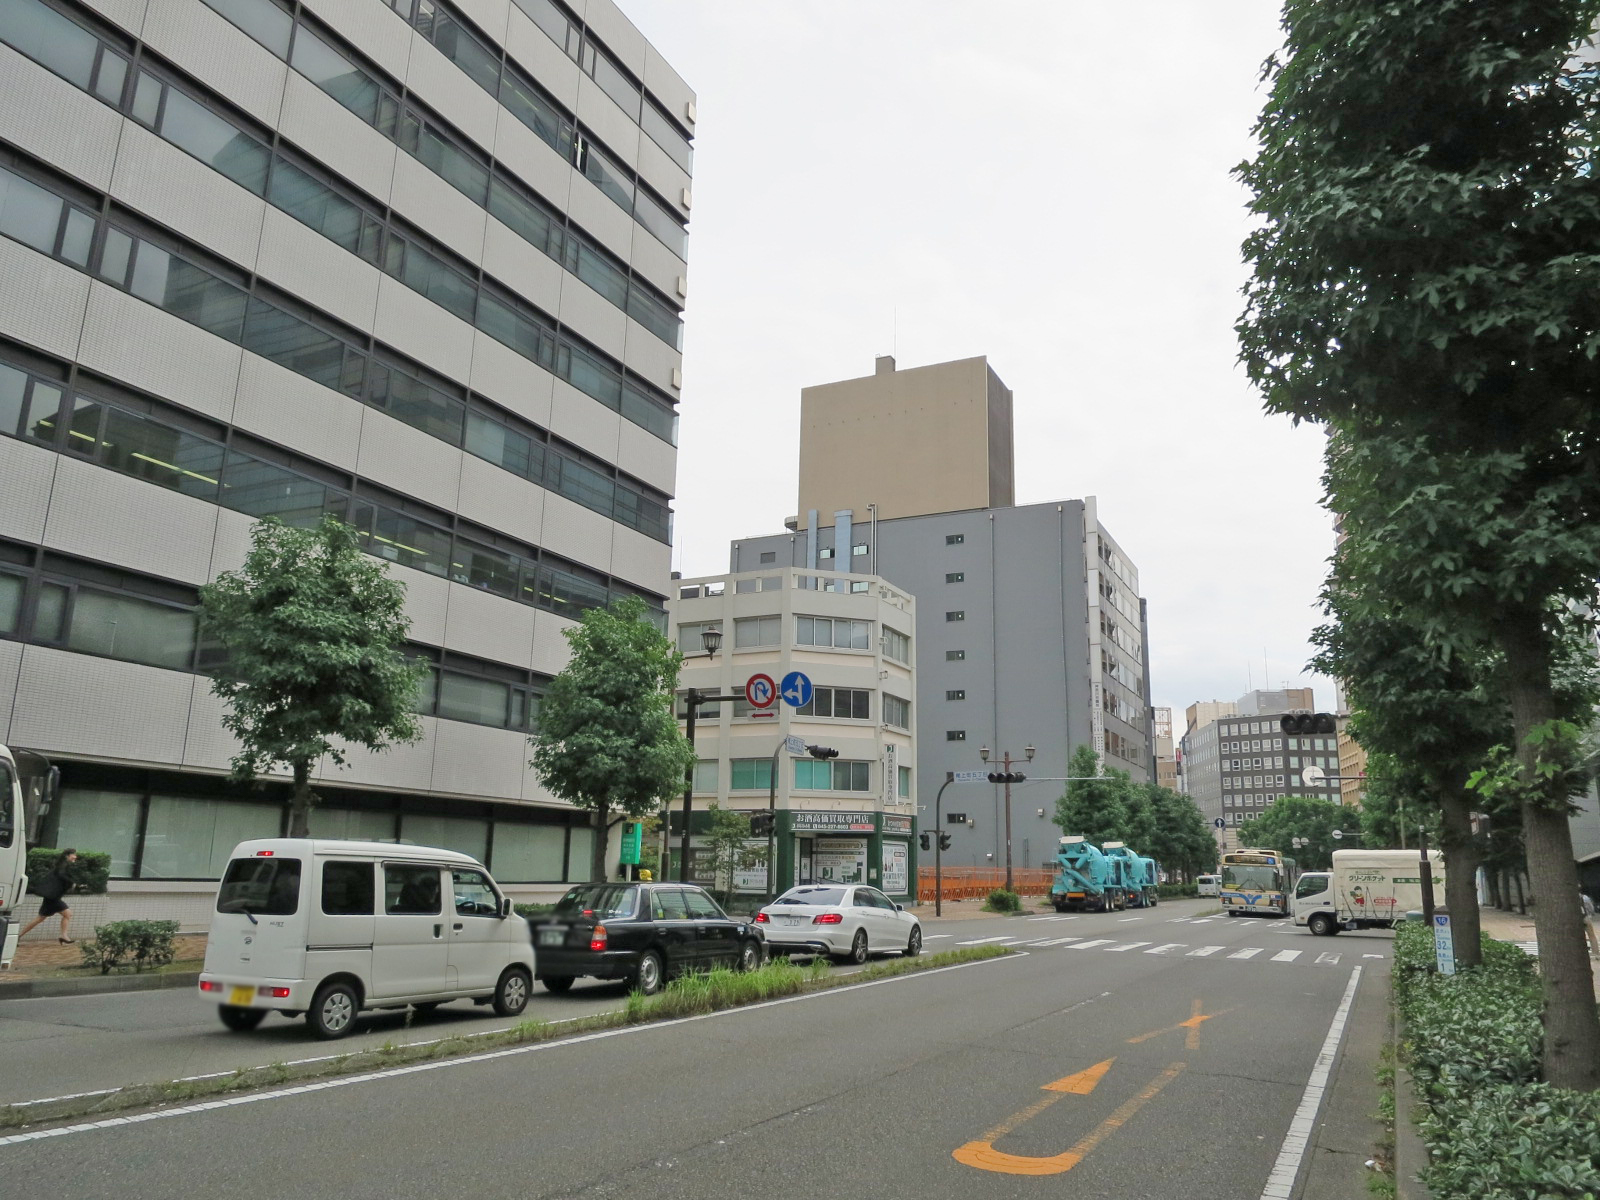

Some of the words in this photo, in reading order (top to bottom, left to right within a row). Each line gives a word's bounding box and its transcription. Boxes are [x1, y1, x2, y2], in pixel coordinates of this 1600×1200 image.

[796, 813, 869, 824] お酒高価買取専門店
[1438, 916, 1447, 925] 16
[1437, 940, 1447, 950] 32
